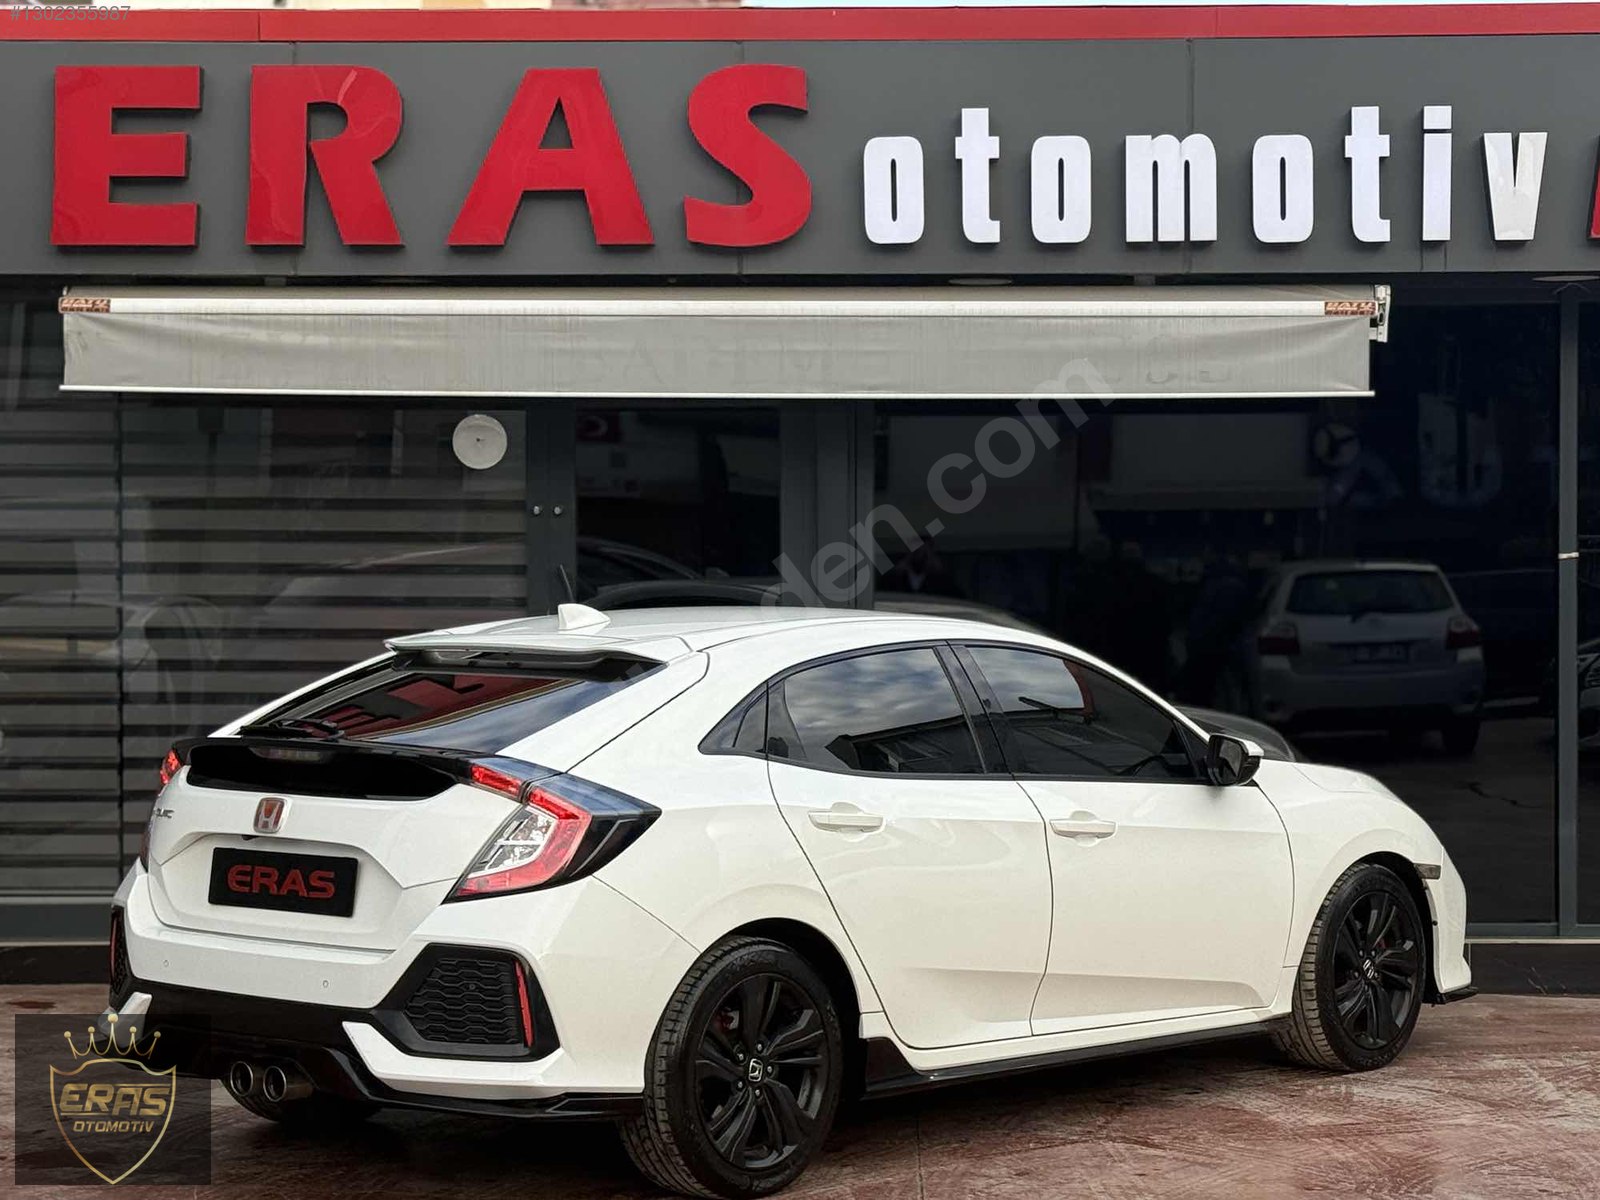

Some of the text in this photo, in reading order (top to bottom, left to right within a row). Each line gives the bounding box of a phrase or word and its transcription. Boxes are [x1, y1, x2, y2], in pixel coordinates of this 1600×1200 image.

[51, 65, 812, 247] ERAS
[863, 105, 1548, 244] otomotiv
[227, 864, 336, 898] ERAS
